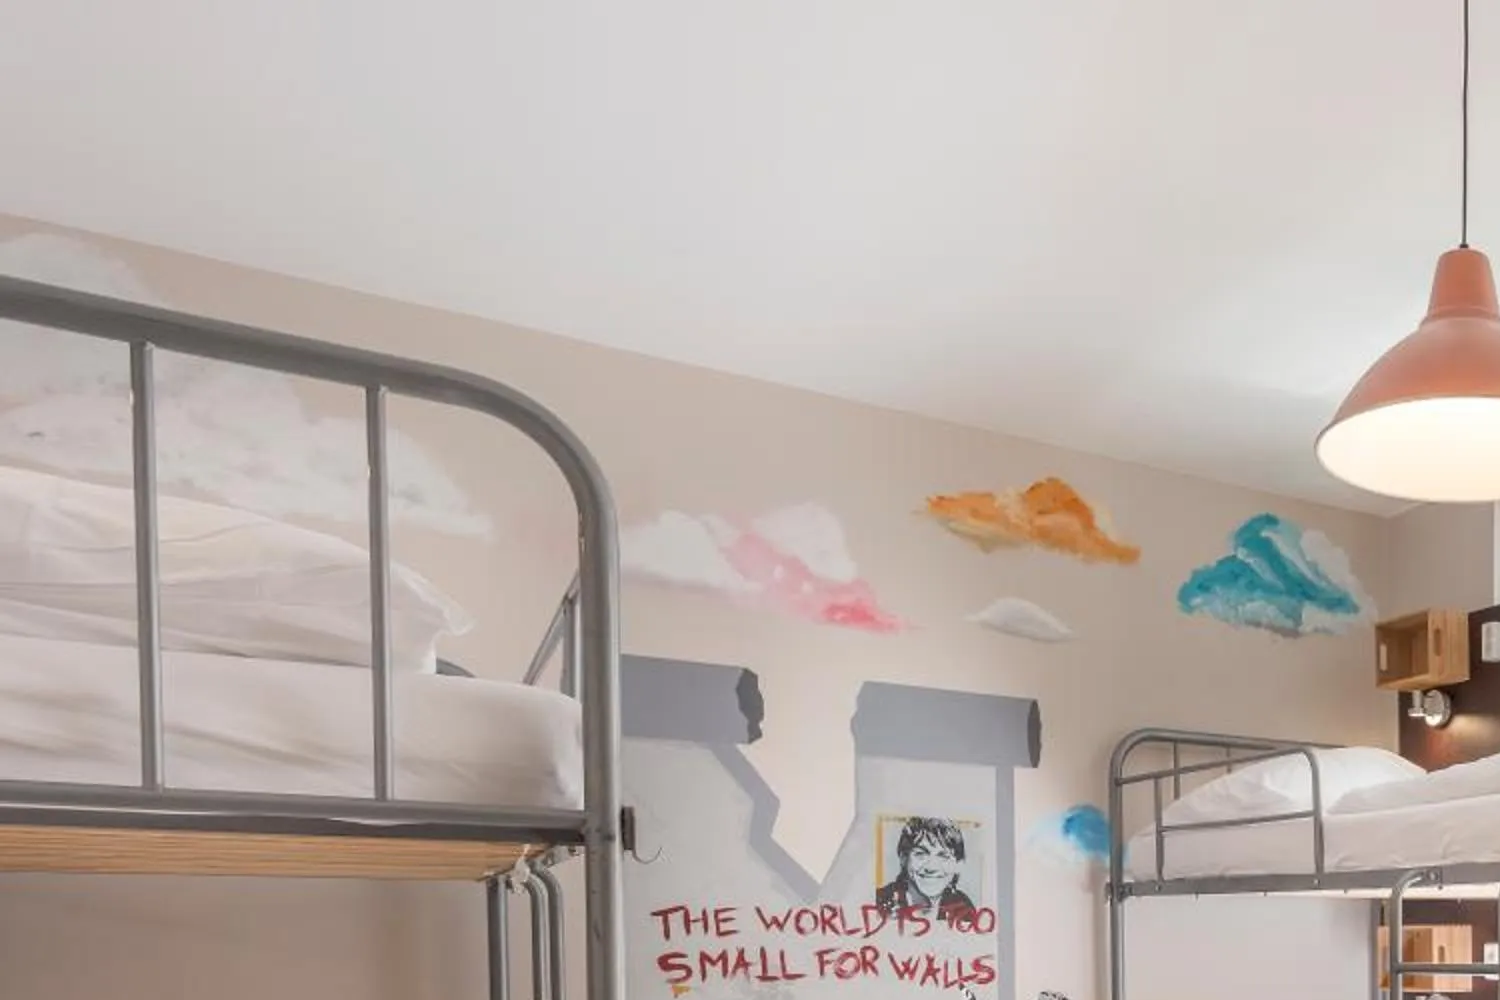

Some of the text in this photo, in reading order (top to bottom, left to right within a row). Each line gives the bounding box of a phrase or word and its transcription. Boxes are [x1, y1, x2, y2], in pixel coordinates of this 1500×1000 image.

[651, 904, 995, 941] THE WORLD IS TOO
[656, 945, 995, 988] SMALL FOR WALLS
